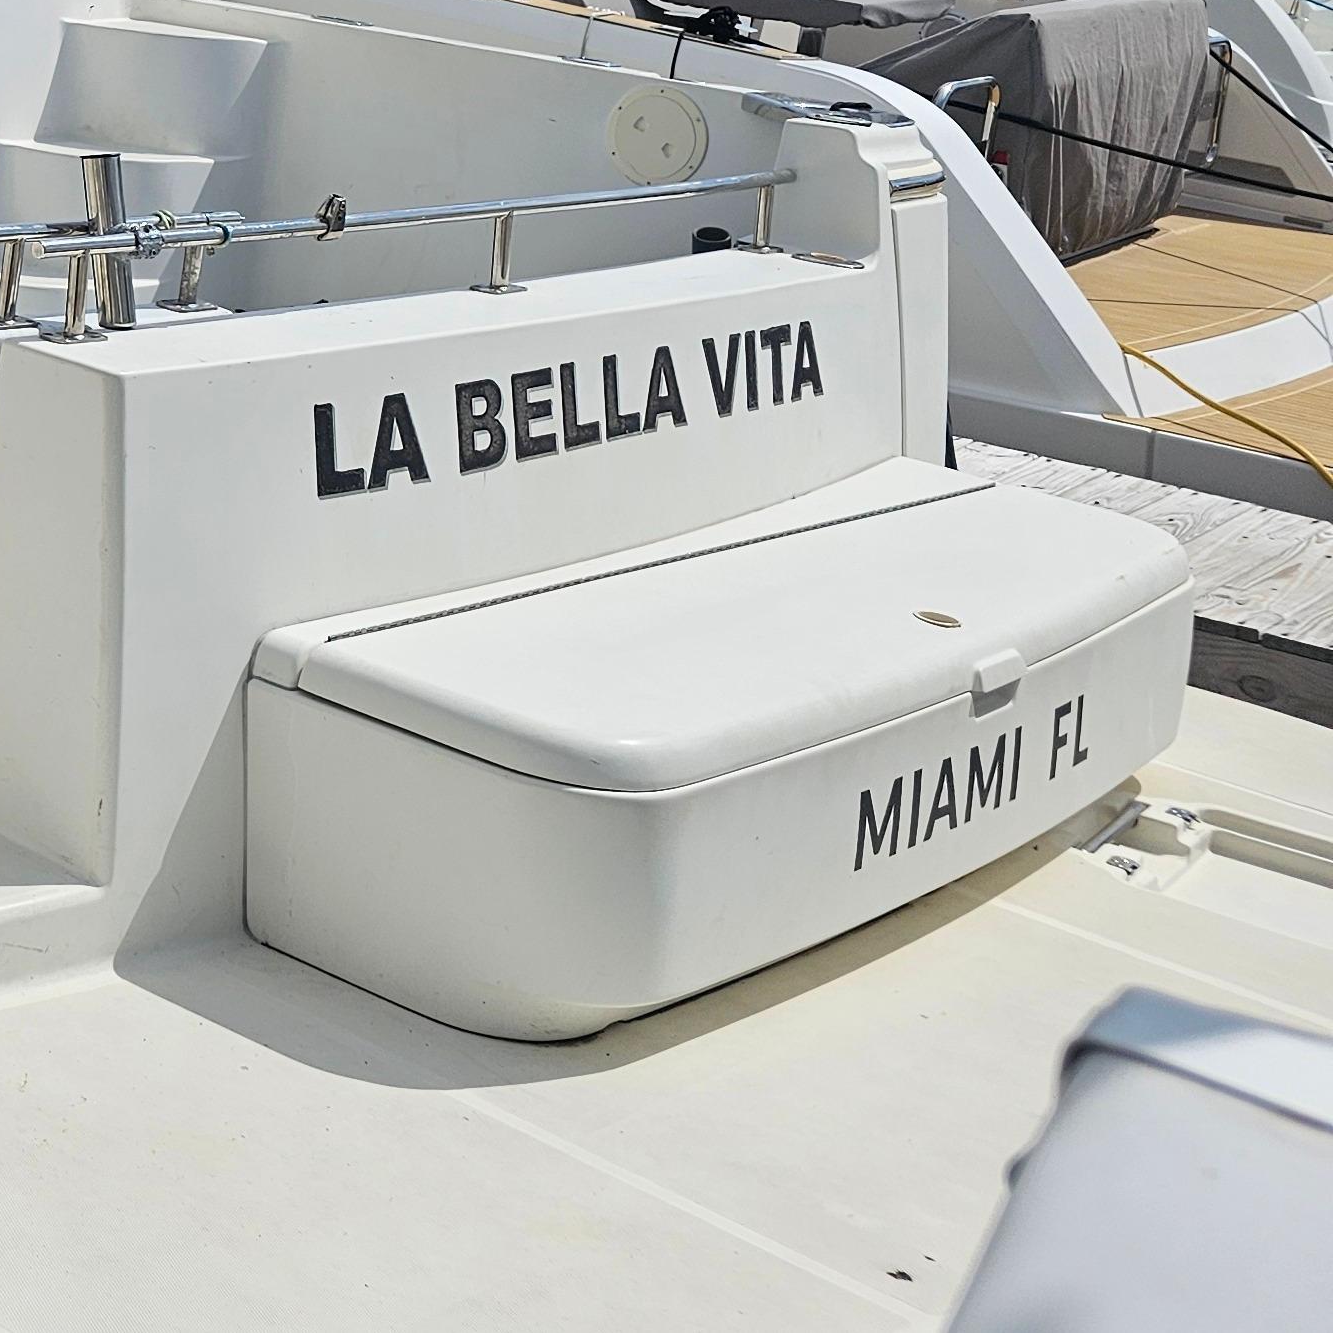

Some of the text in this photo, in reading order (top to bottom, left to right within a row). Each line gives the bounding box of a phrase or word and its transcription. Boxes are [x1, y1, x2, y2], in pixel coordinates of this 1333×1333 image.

[313, 320, 824, 500] LA BELLA VITA
[853, 694, 1089, 872] MIAMI FL
